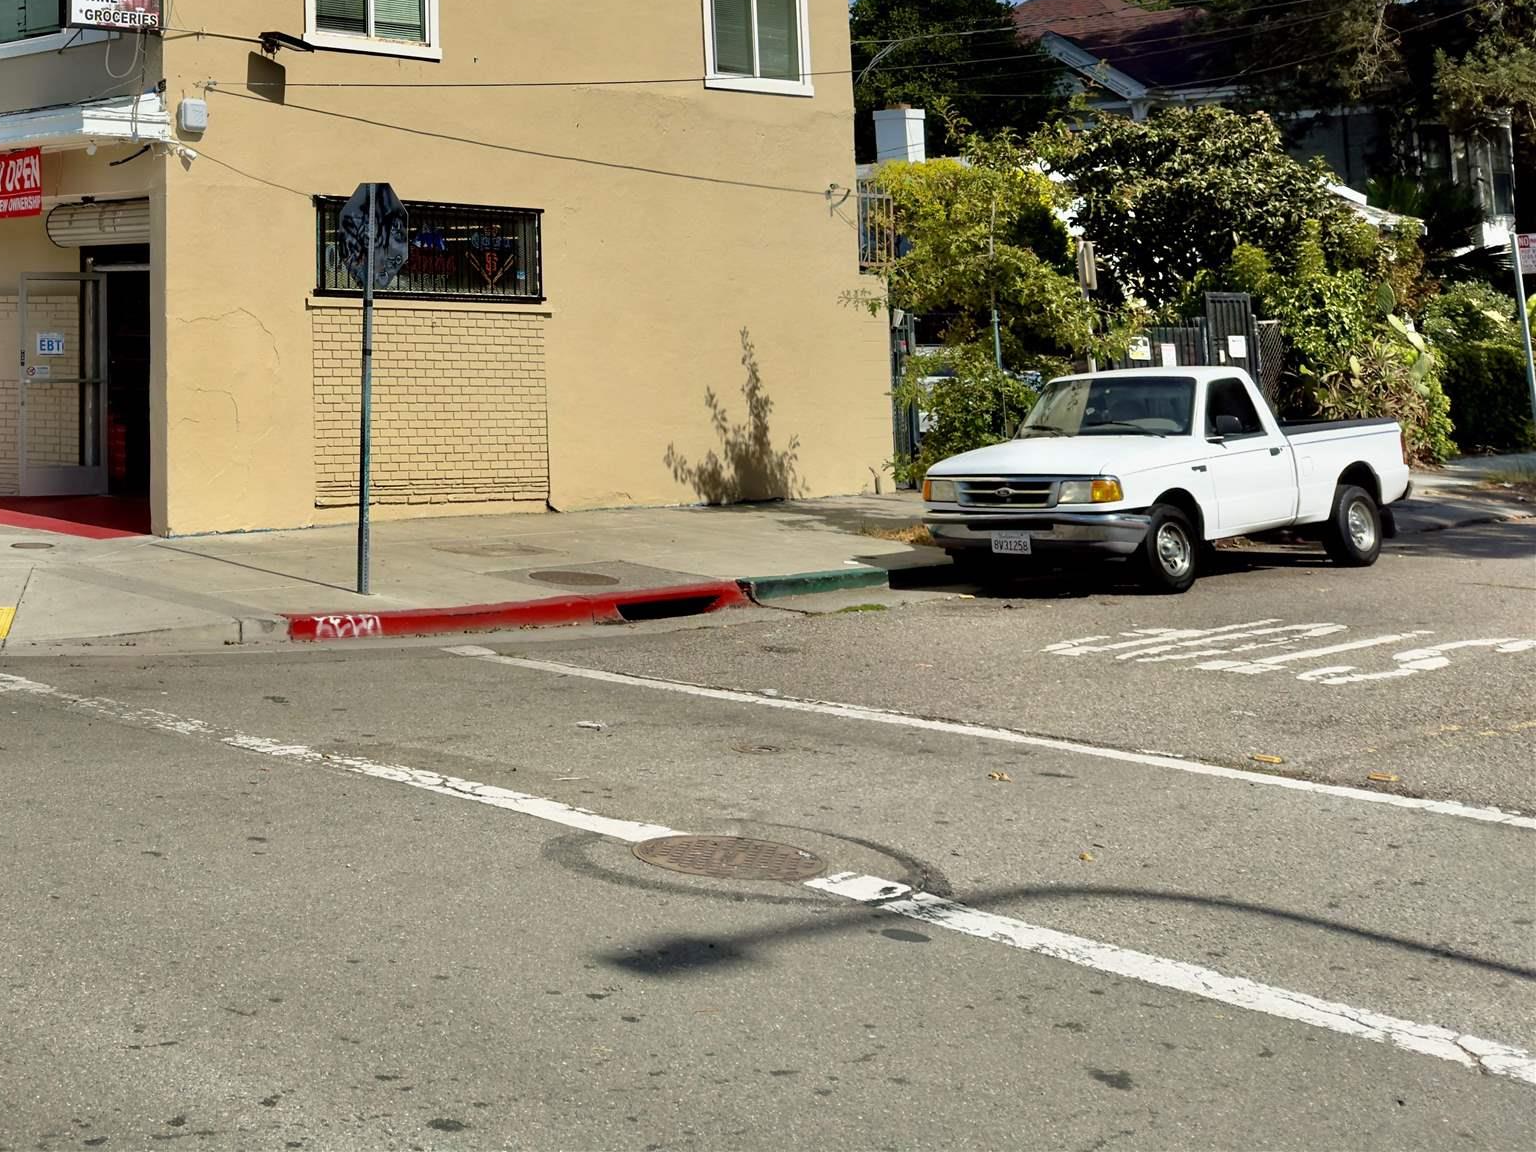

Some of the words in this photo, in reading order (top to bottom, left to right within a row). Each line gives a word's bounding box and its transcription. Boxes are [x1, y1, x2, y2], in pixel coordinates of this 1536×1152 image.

[7, 155, 40, 191] OPEN
[8, 196, 41, 212] OWNERSHIP
[1518, 236, 1529, 247] NO
[40, 340, 62, 352] EBT
